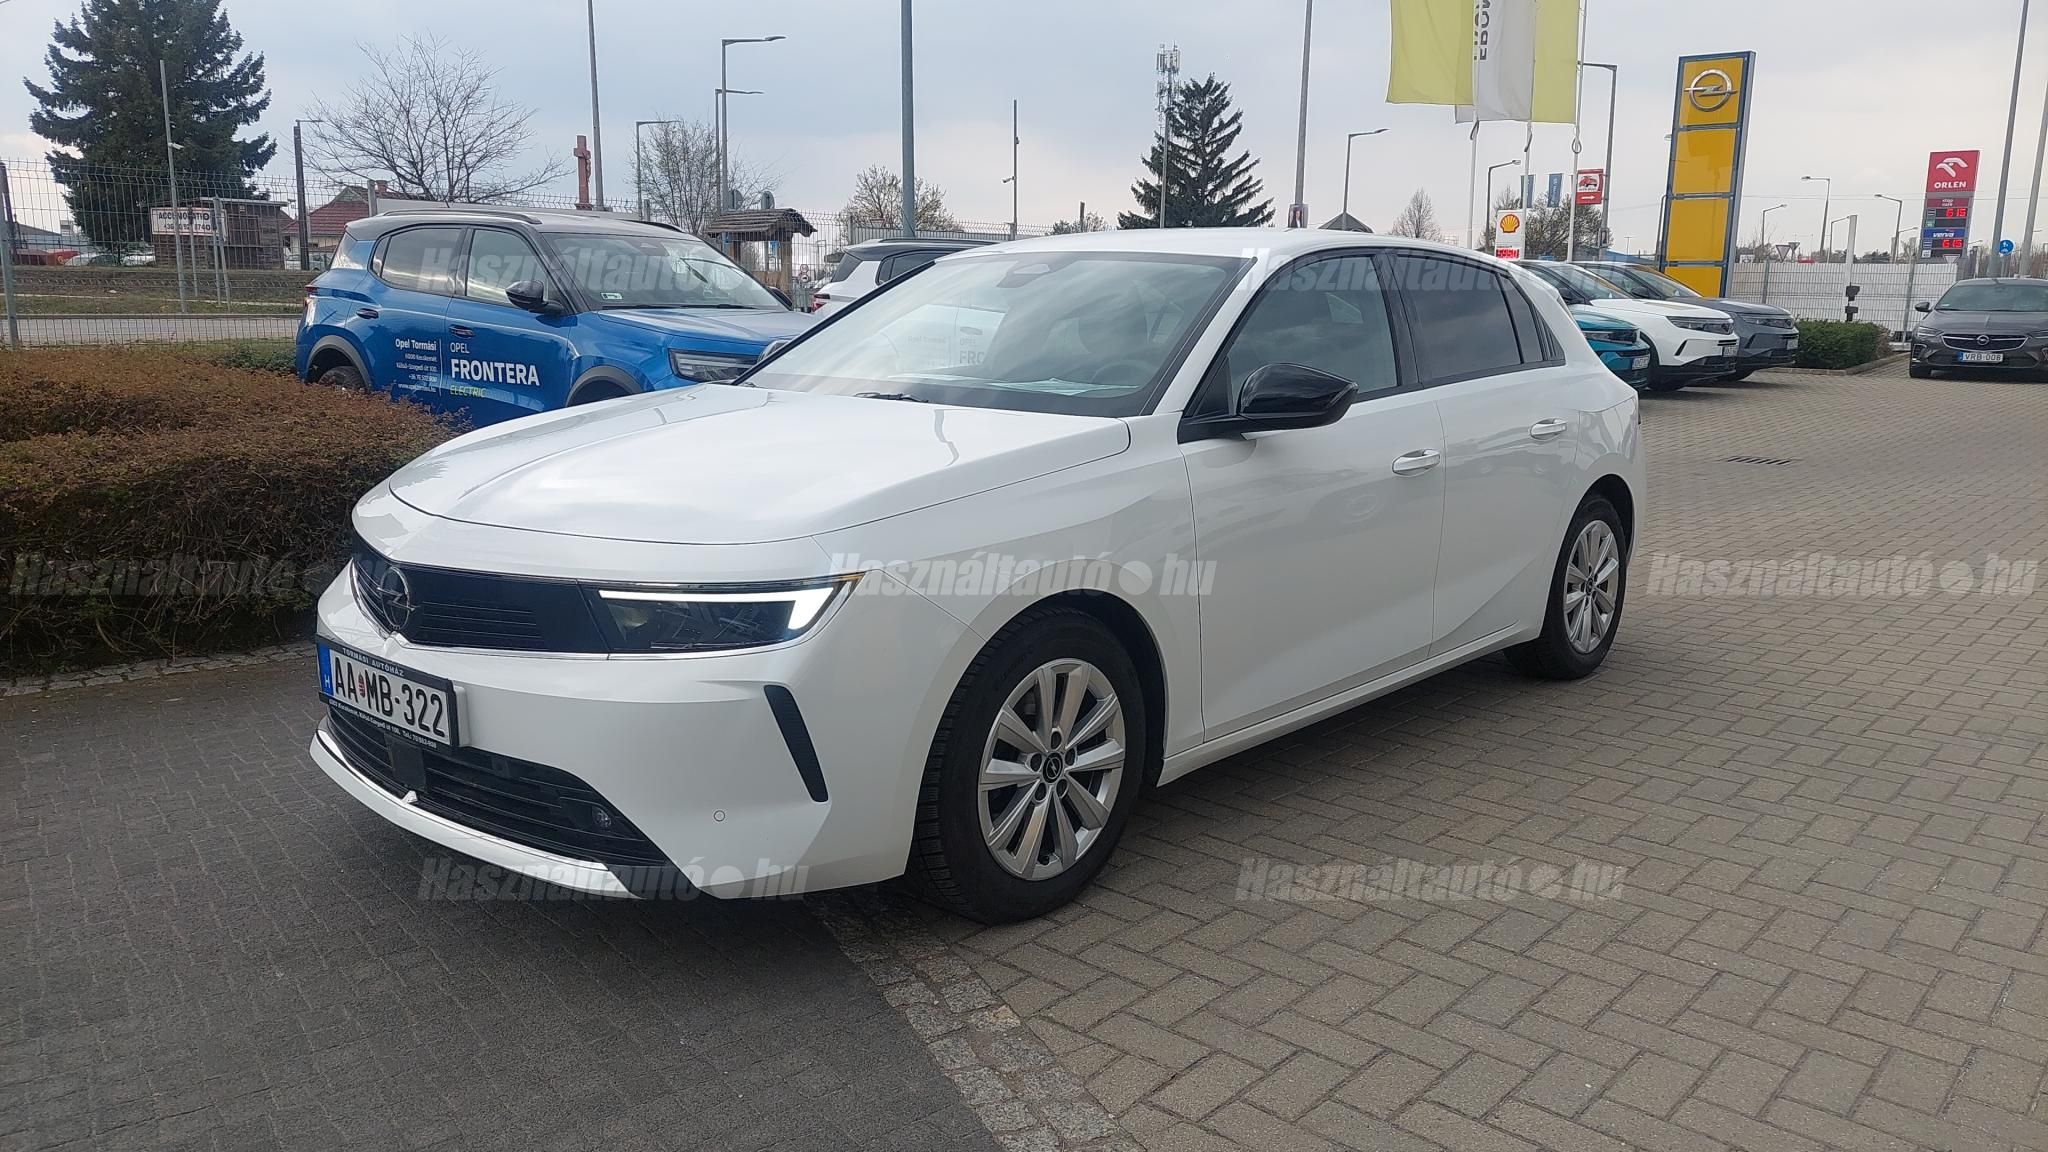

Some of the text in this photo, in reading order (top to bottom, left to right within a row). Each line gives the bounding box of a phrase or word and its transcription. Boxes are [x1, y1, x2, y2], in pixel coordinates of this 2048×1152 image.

[1934, 181, 1966, 189] ORLEN
[1946, 208, 1966, 217] 615
[1942, 239, 1962, 248] 615
[395, 338, 410, 349] Opel
[450, 342, 470, 354] OPEL
[450, 358, 540, 386] FRONTERA
[450, 385, 486, 398] ELECTRIC
[335, 656, 445, 738] AA MB-322
